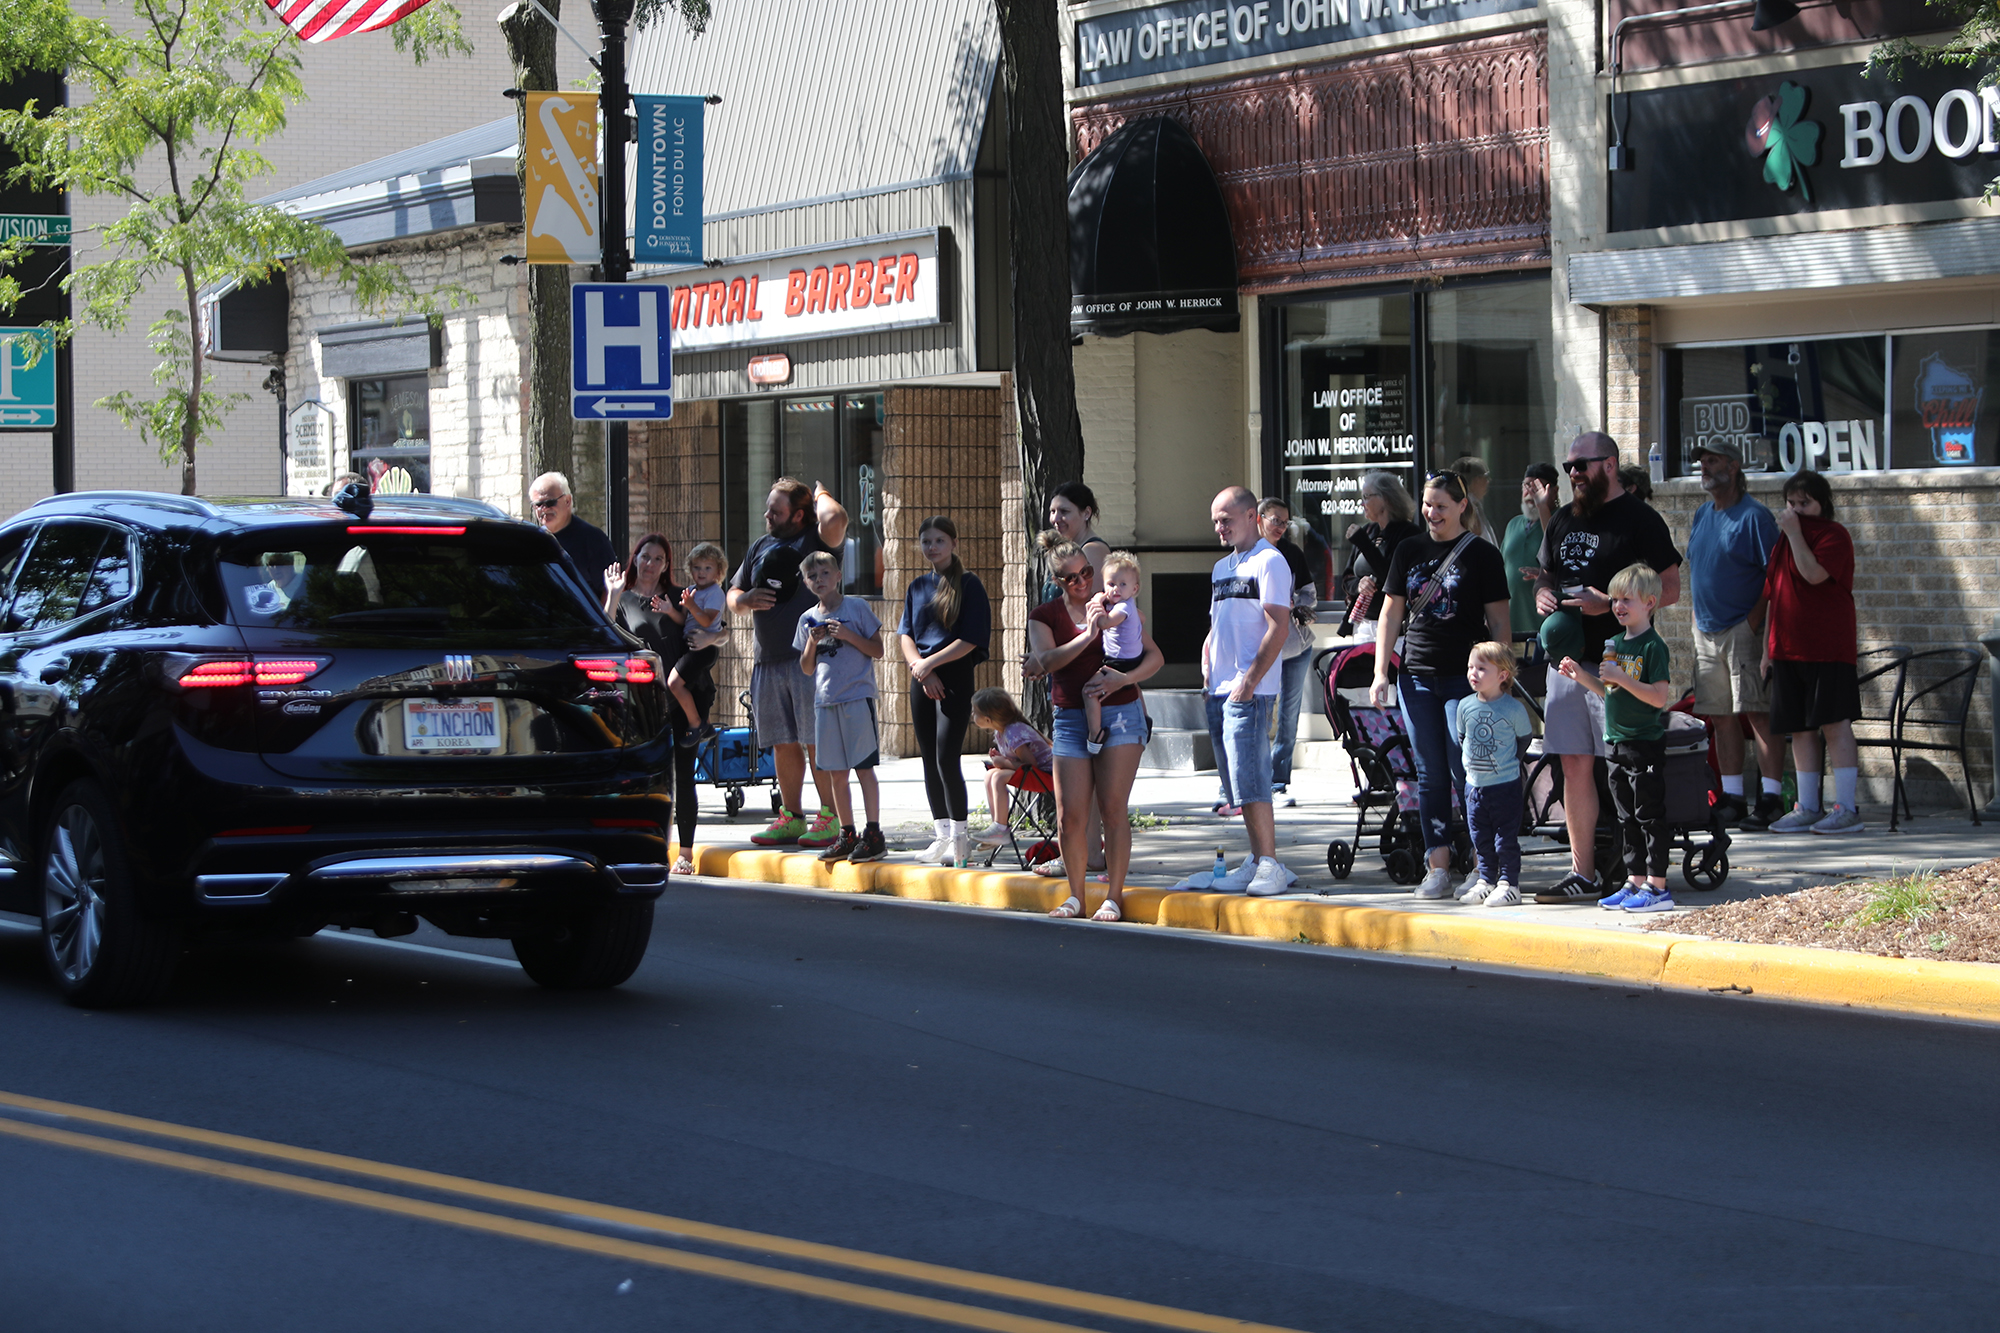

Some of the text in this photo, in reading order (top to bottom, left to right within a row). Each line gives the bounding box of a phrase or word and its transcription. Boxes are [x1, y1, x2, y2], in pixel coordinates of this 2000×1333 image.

[1080, 28, 1133, 72] LAW
[1138, 11, 1227, 61] OFFICE
[1234, 0, 1271, 43] OF
[1276, 0, 1351, 35] JOHN
[653, 103, 667, 229] DOWNTOWN
[673, 117, 685, 216] FOND DU LAC
[784, 253, 919, 316] BARBER
[1086, 303, 1115, 313] OFFICE
[1119, 302, 1132, 311] OF
[1136, 300, 1161, 310] JOHN
[1166, 299, 1176, 308] W.
[1180, 298, 1222, 308] HERRICK
[585, 291, 659, 385] H
[1313, 387, 1383, 408] LAW OFFICE
[1340, 413, 1356, 432] OF
[1694, 402, 1749, 434] BUD
[1922, 398, 1977, 428] Chill
[1285, 434, 1414, 457] JOHN W. HERRICK, LLC
[1779, 419, 1878, 473] OPEN
[1296, 478, 1333, 495] Attorney
[1334, 476, 1357, 492] John
[286, 703, 322, 714] Holiday
[431, 712, 495, 736] INCHON
[437, 738, 471, 747] KOREA
